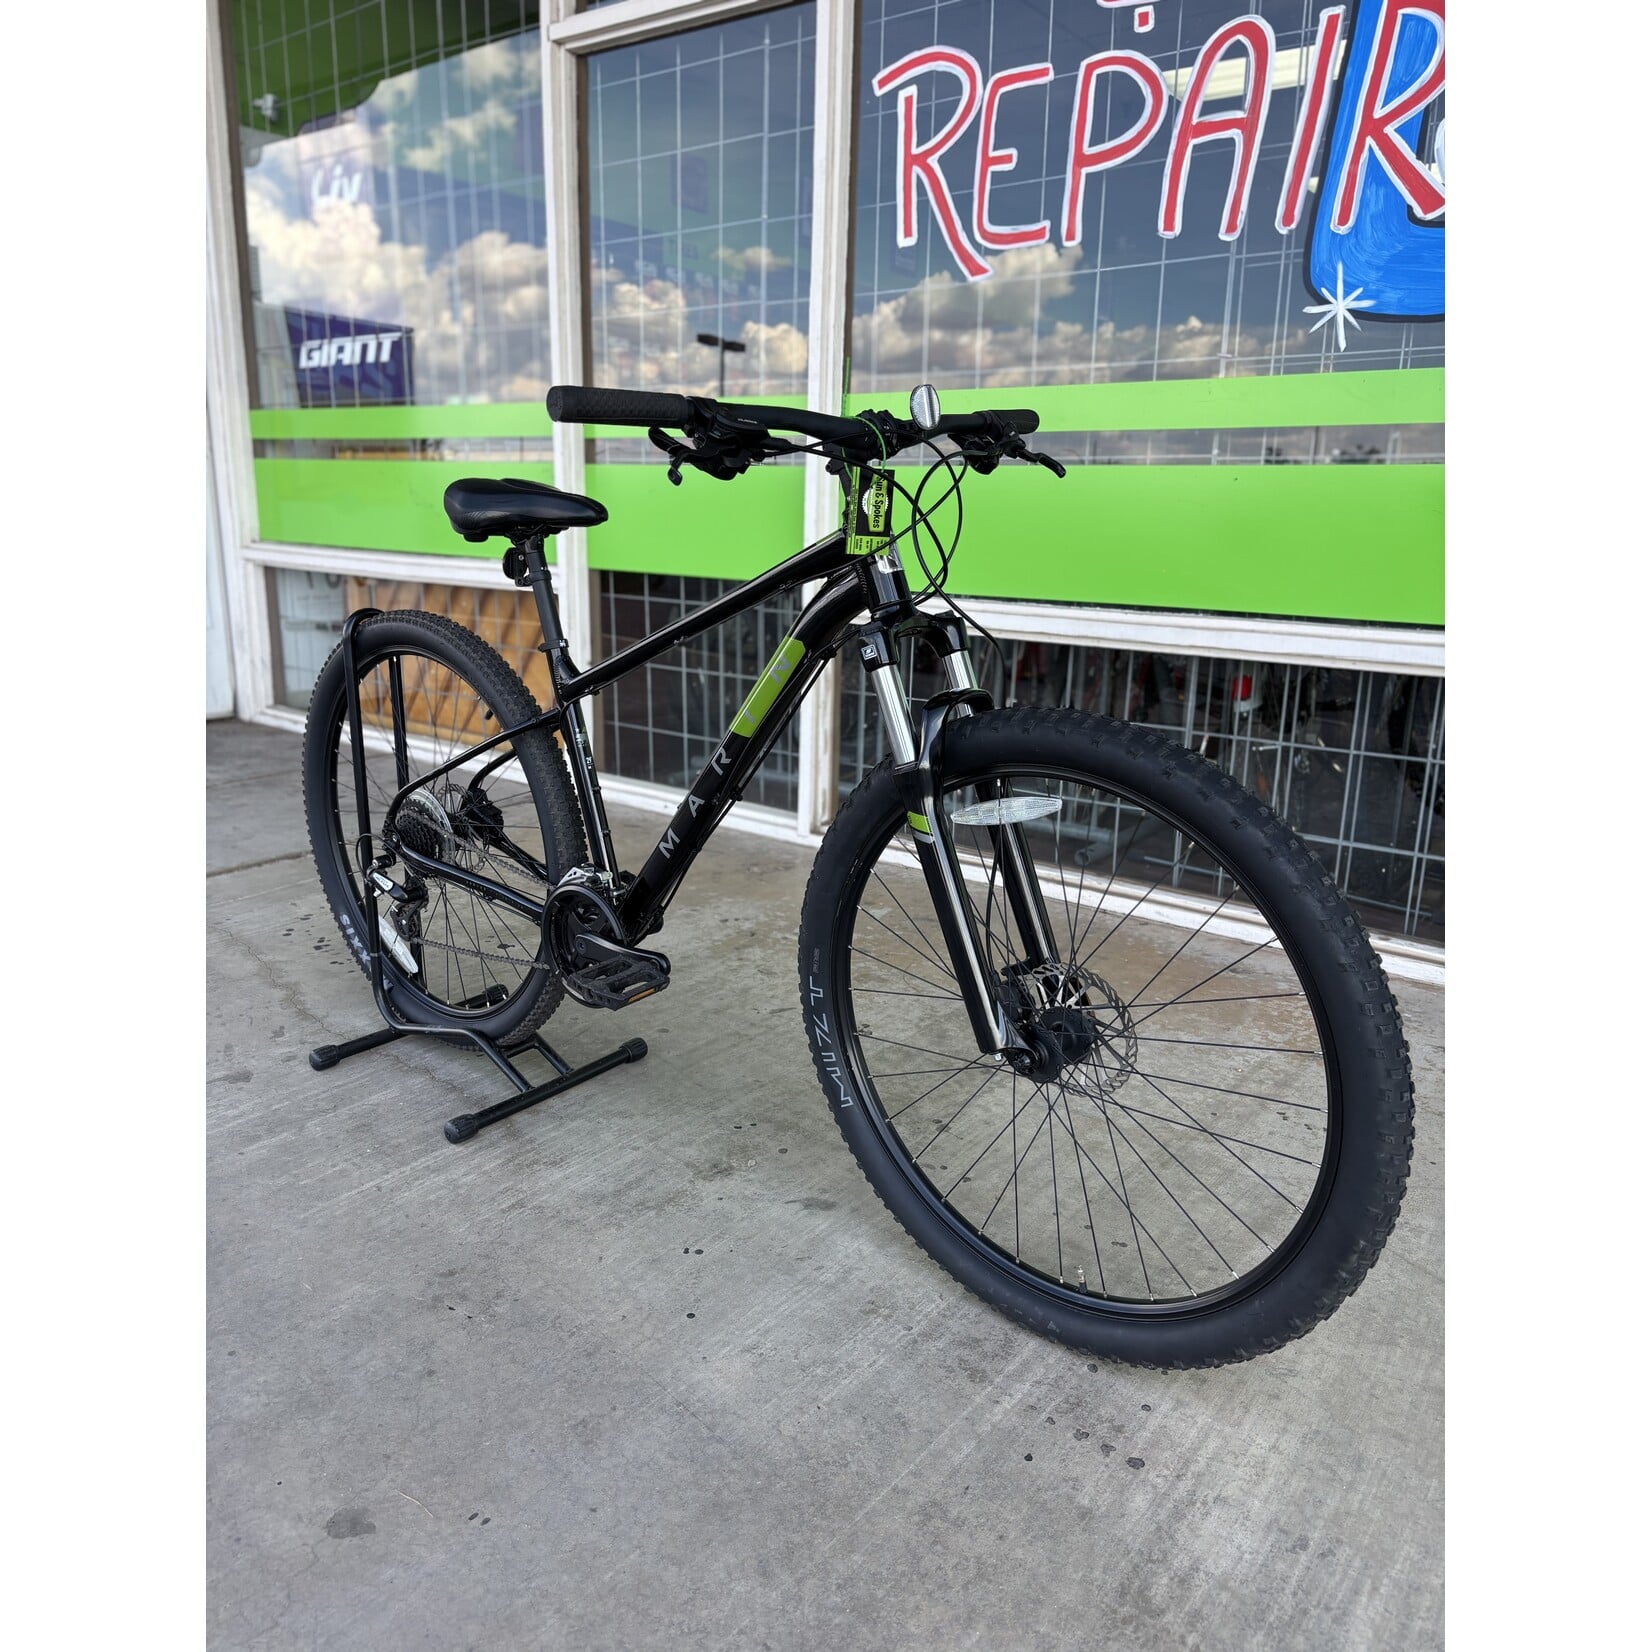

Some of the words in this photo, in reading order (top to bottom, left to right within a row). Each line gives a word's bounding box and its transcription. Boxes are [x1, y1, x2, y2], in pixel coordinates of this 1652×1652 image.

[872, 0, 1445, 282] REPAIR
[311, 164, 363, 204] Liv
[299, 331, 403, 369] GIANT
[872, 500, 884, 529] Spokes
[658, 653, 792, 859] MARIN
